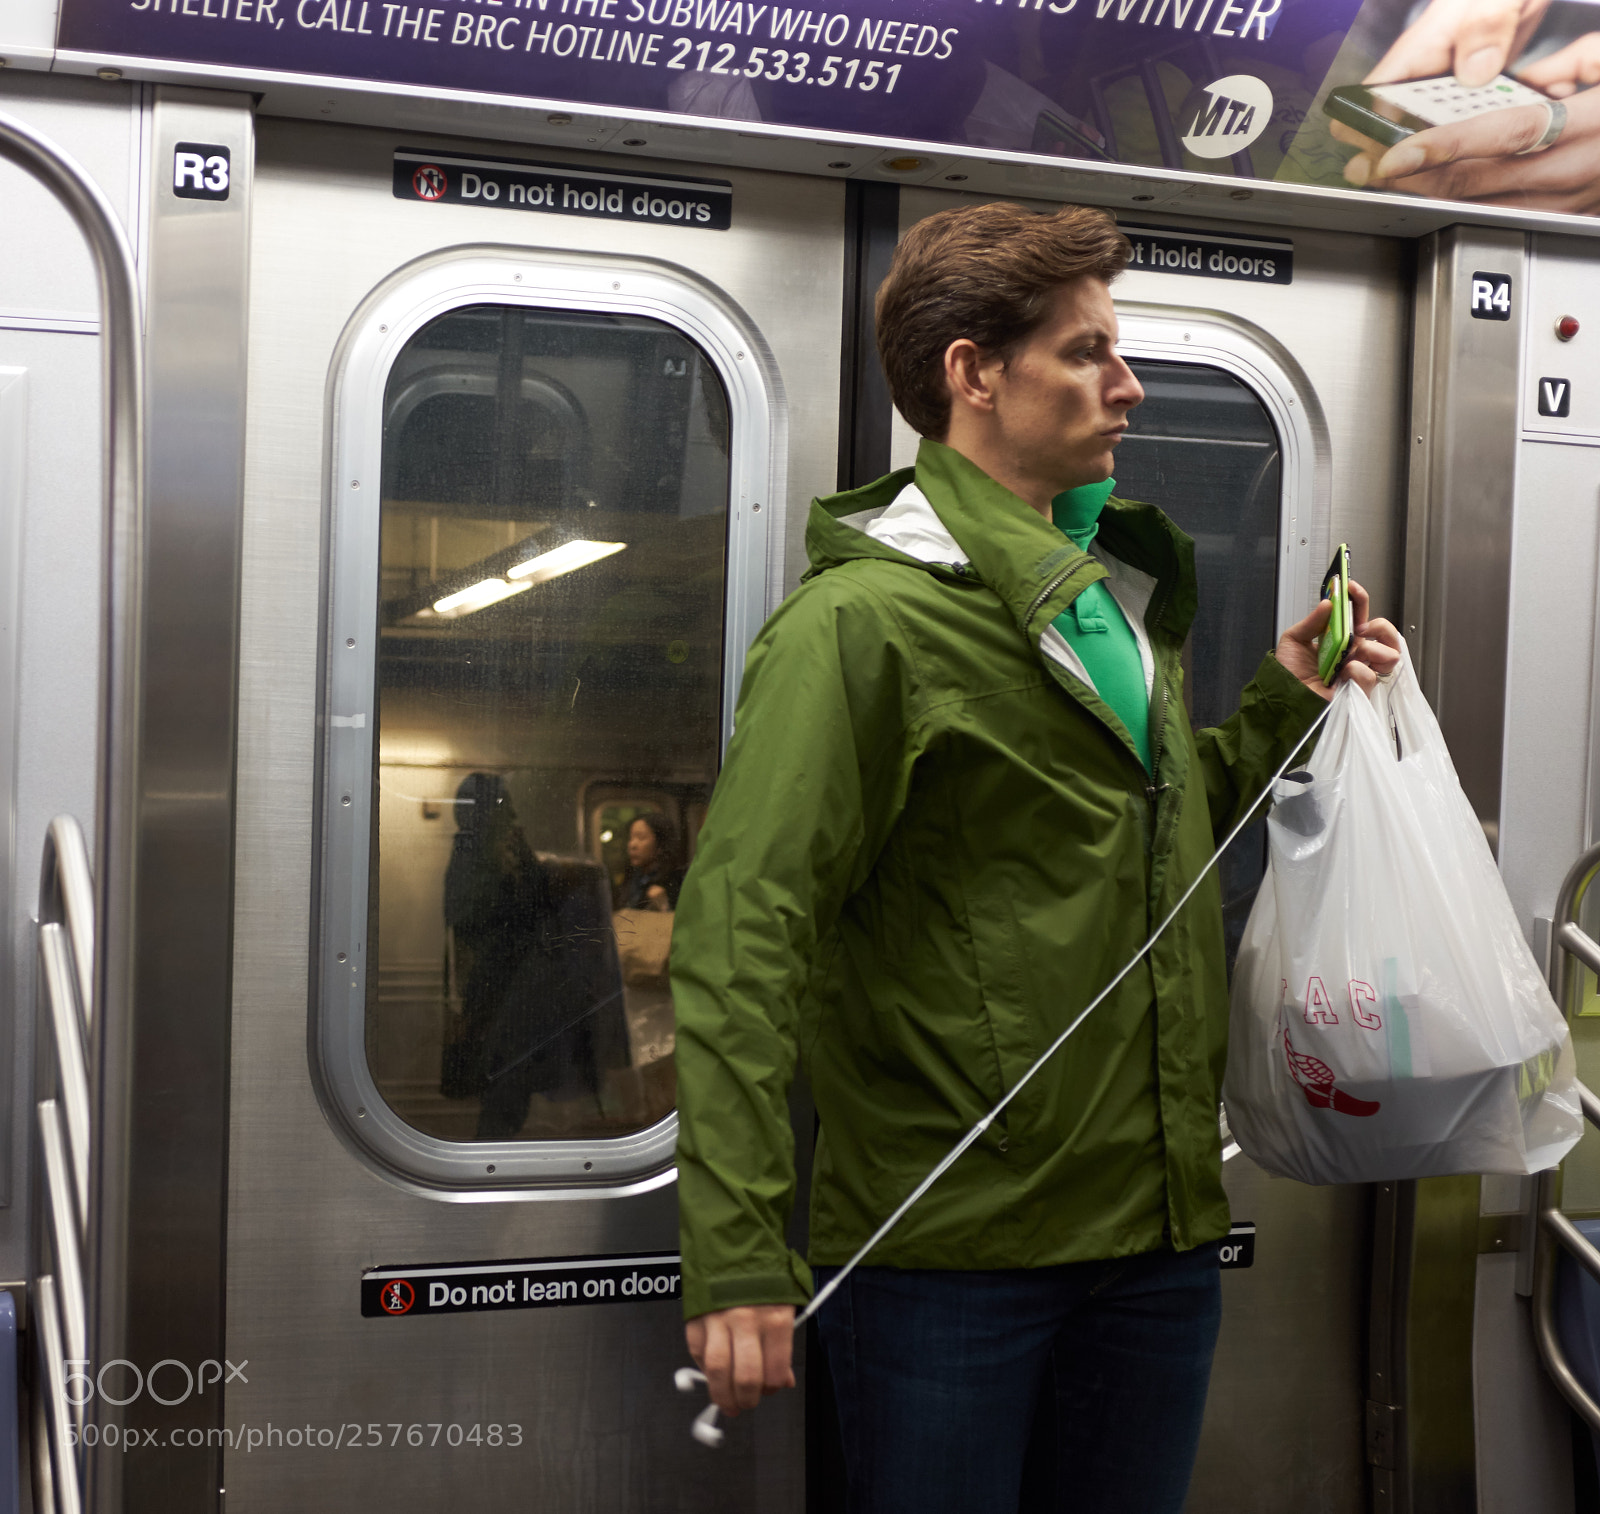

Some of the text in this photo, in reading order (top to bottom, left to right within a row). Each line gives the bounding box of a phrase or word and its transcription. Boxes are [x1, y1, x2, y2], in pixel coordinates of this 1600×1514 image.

[296, 0, 373, 35] CALL
[382, 3, 445, 42] THE
[451, 12, 520, 50] BRC
[525, 20, 663, 66] HOTLINE
[667, 37, 902, 94] 212.533.5151
[625, 0, 775, 36] SUBWAY
[769, 6, 850, 47] WHO
[854, 17, 960, 60] NEEDS
[174, 151, 229, 192] R3
[460, 173, 711, 222] Do not hold doors
[1150, 242, 1202, 270] hold
[1209, 250, 1276, 277] doors
[1472, 279, 1510, 312] R4
[1544, 382, 1566, 413] V
[1276, 976, 1382, 1031] AC
[1219, 1245, 1243, 1263] or
[429, 1272, 680, 1307] Do not lean on door
